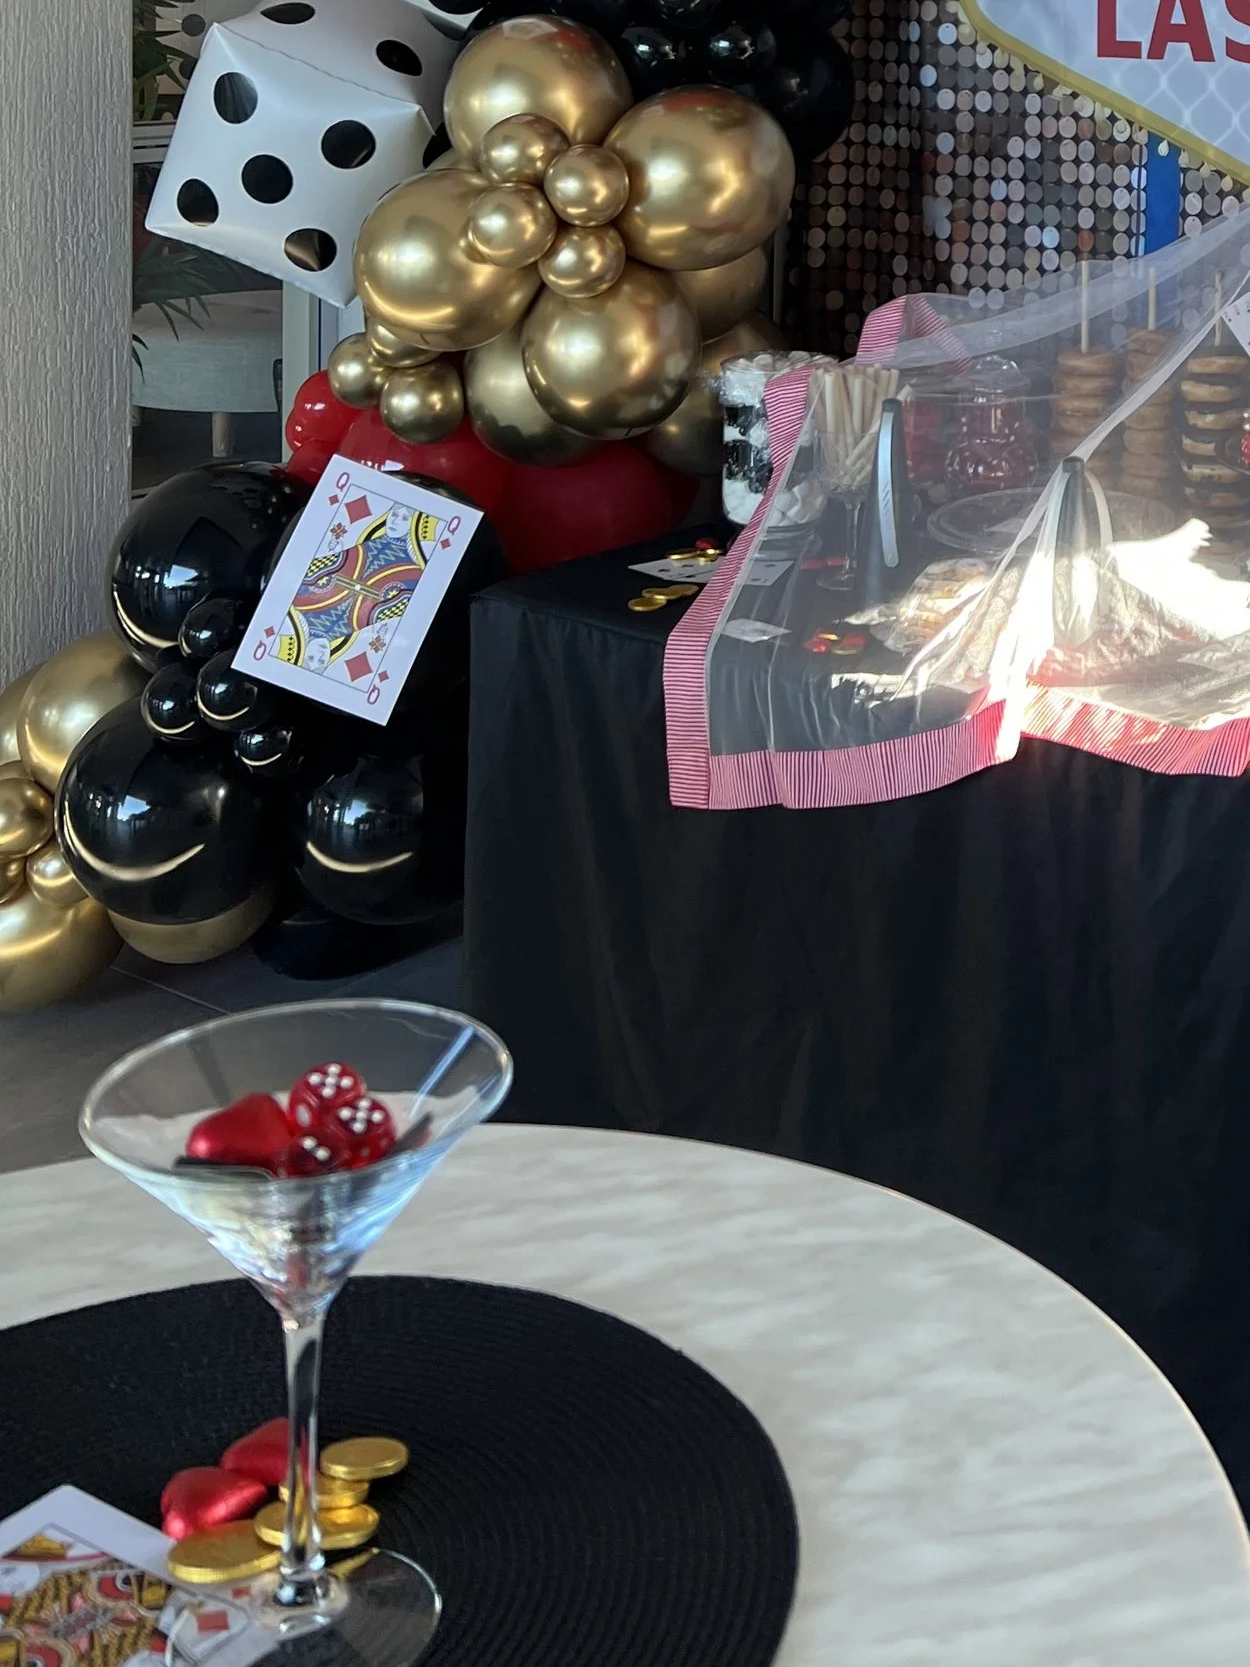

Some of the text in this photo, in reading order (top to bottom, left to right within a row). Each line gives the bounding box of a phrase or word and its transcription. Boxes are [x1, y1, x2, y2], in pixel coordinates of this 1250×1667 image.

[336, 472, 350, 492] Q
[448, 516, 461, 535] Q
[253, 640, 267, 661] Q
[366, 684, 380, 705] Q
